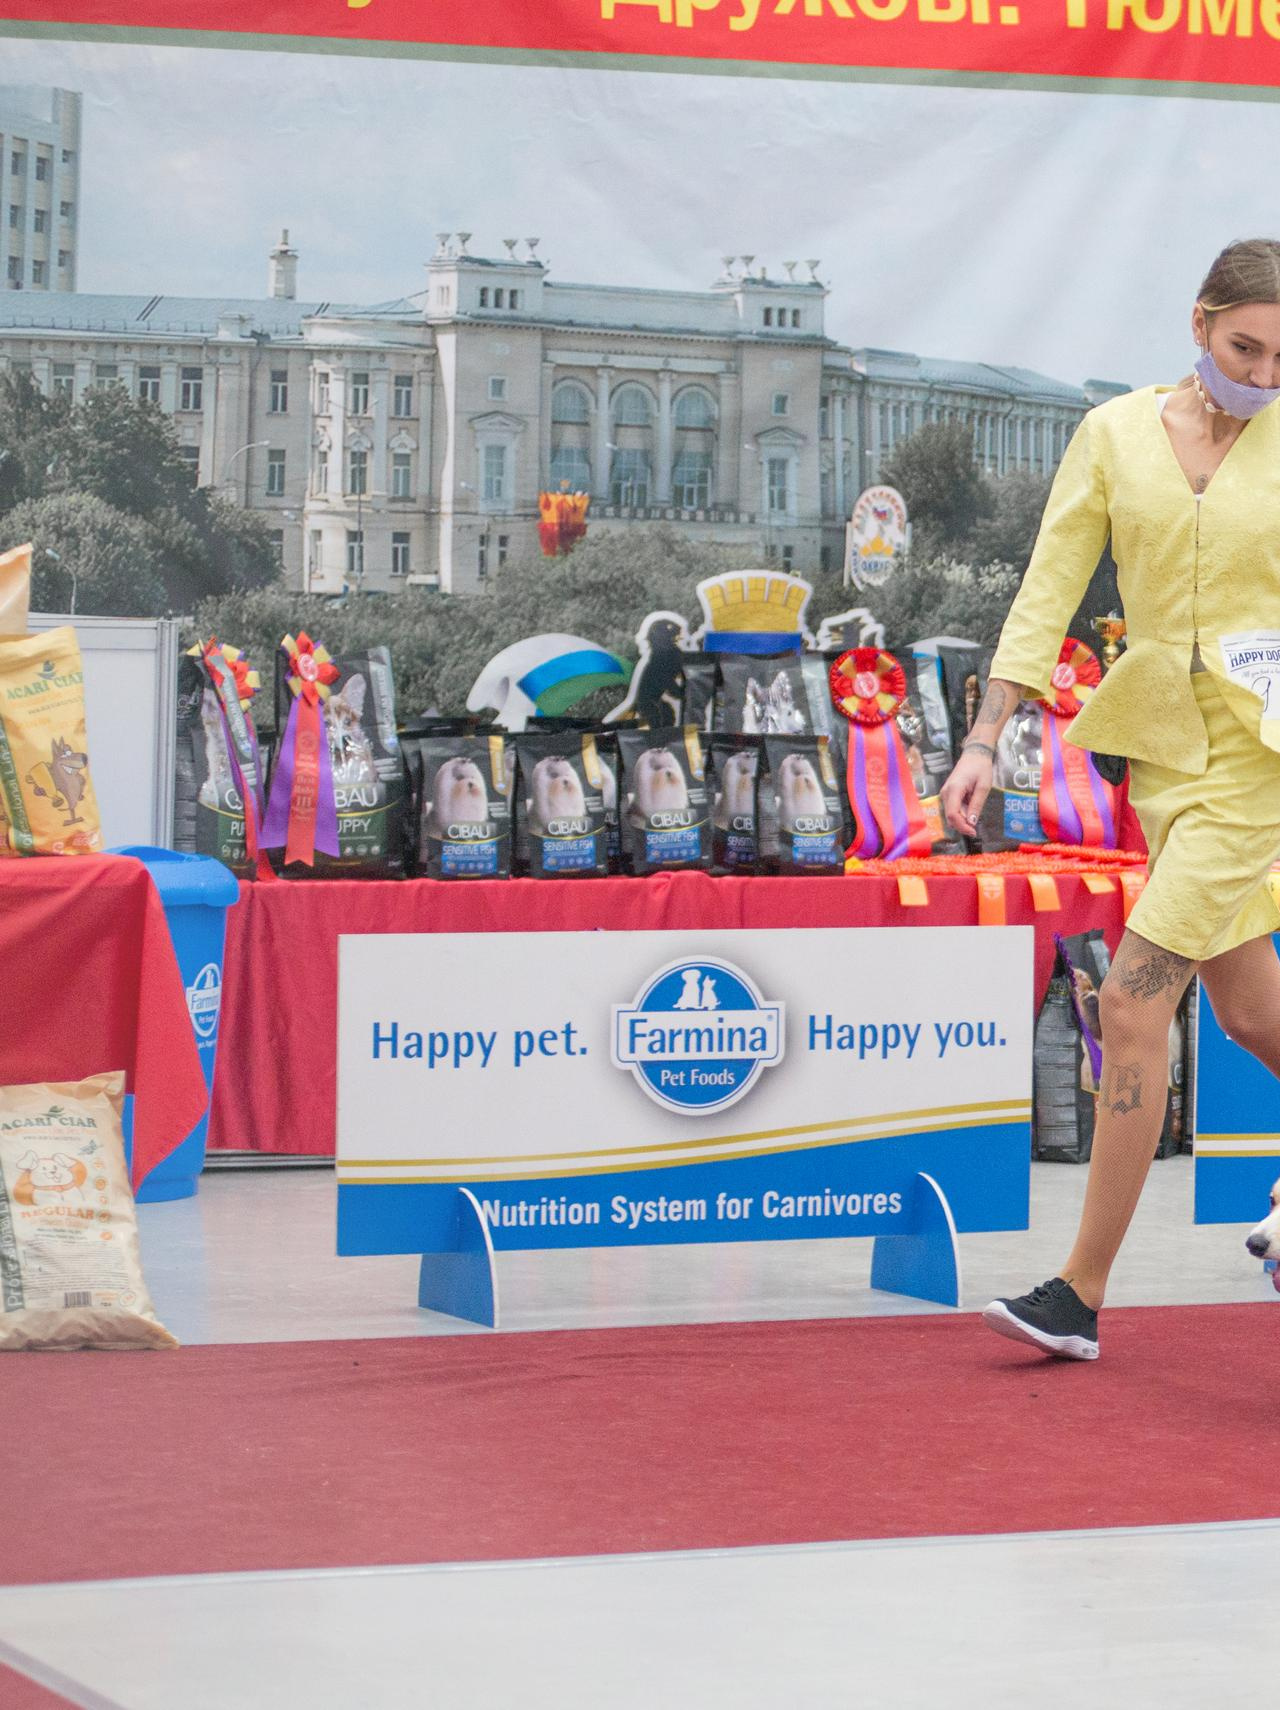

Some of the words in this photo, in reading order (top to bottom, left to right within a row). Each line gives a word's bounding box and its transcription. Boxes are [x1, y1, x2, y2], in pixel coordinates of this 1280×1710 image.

[1229, 650, 1264, 667] HAPPY
[335, 788, 378, 808] BAU
[1004, 798, 1039, 812] SENSIT
[547, 820, 588, 836] CIBAU
[650, 813, 692, 828] CIBAU
[733, 816, 752, 831] CIB
[795, 818, 830, 832] CIBAU
[447, 824, 491, 840] CIBAU
[628, 1017, 768, 1054] Farmina
[808, 1014, 922, 1060] Happy
[933, 1021, 1007, 1058] you.
[372, 1021, 498, 1069] Happy
[513, 1021, 588, 1067] pet.
[660, 1069, 686, 1086] Pet
[690, 1068, 736, 1086] Foods
[482, 1196, 600, 1227] Nutrition
[610, 1194, 707, 1229] System
[716, 1192, 753, 1220] for
[762, 1188, 902, 1218] Carnivores
